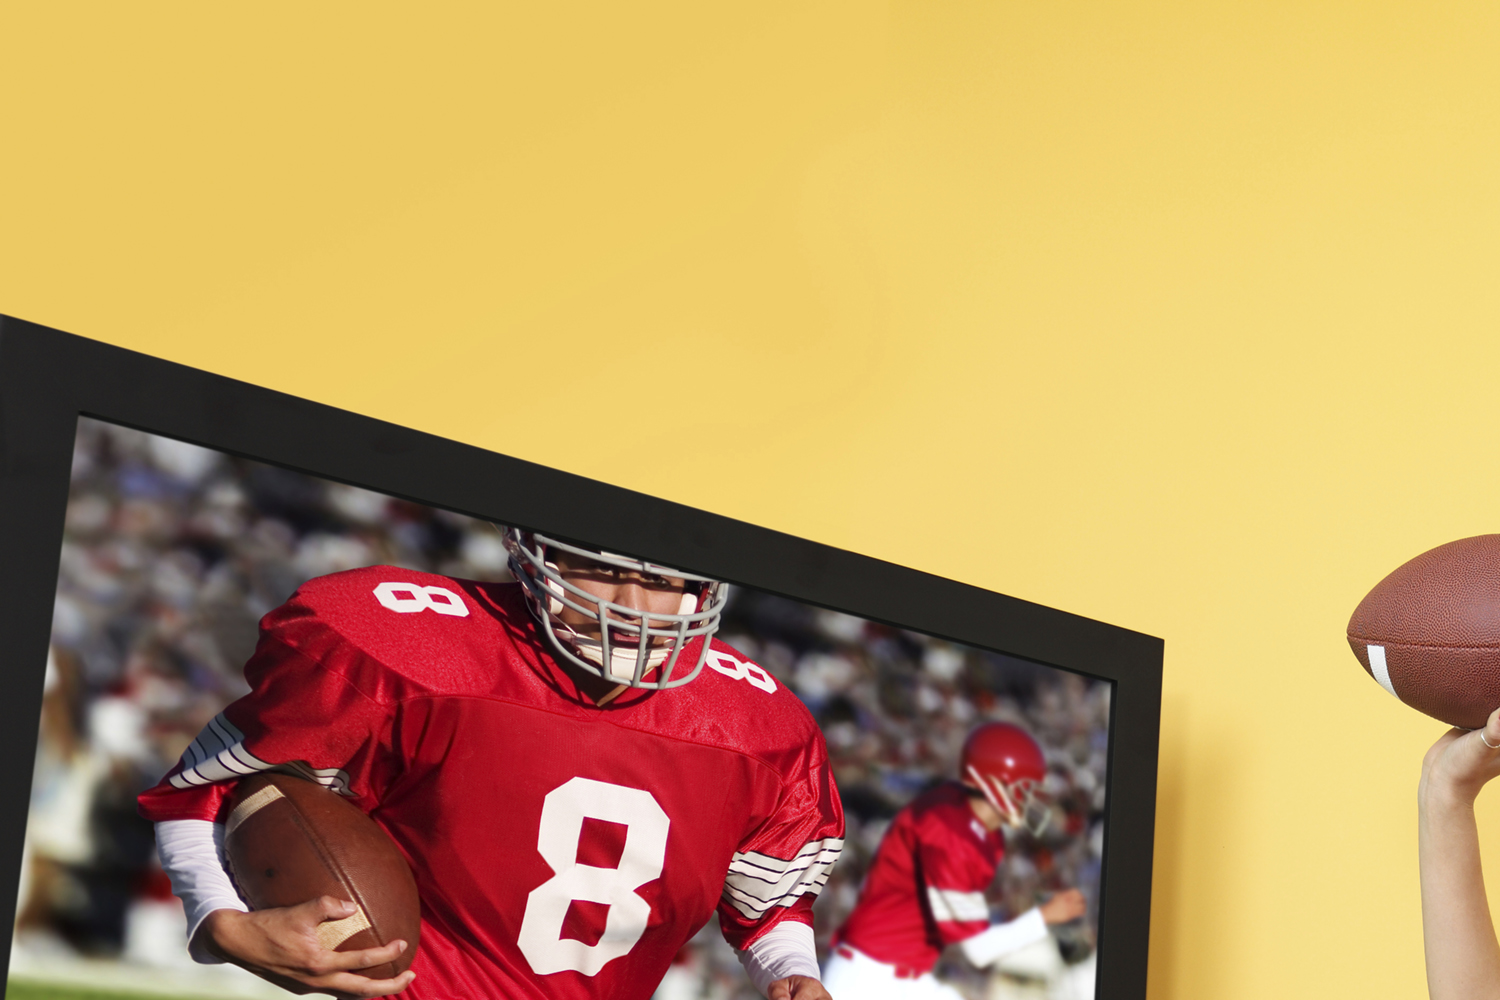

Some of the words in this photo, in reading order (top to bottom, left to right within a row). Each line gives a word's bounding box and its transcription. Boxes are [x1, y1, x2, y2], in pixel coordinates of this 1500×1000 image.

[373, 582, 469, 617] 8
[706, 649, 777, 694] 8
[517, 777, 670, 977] 8
